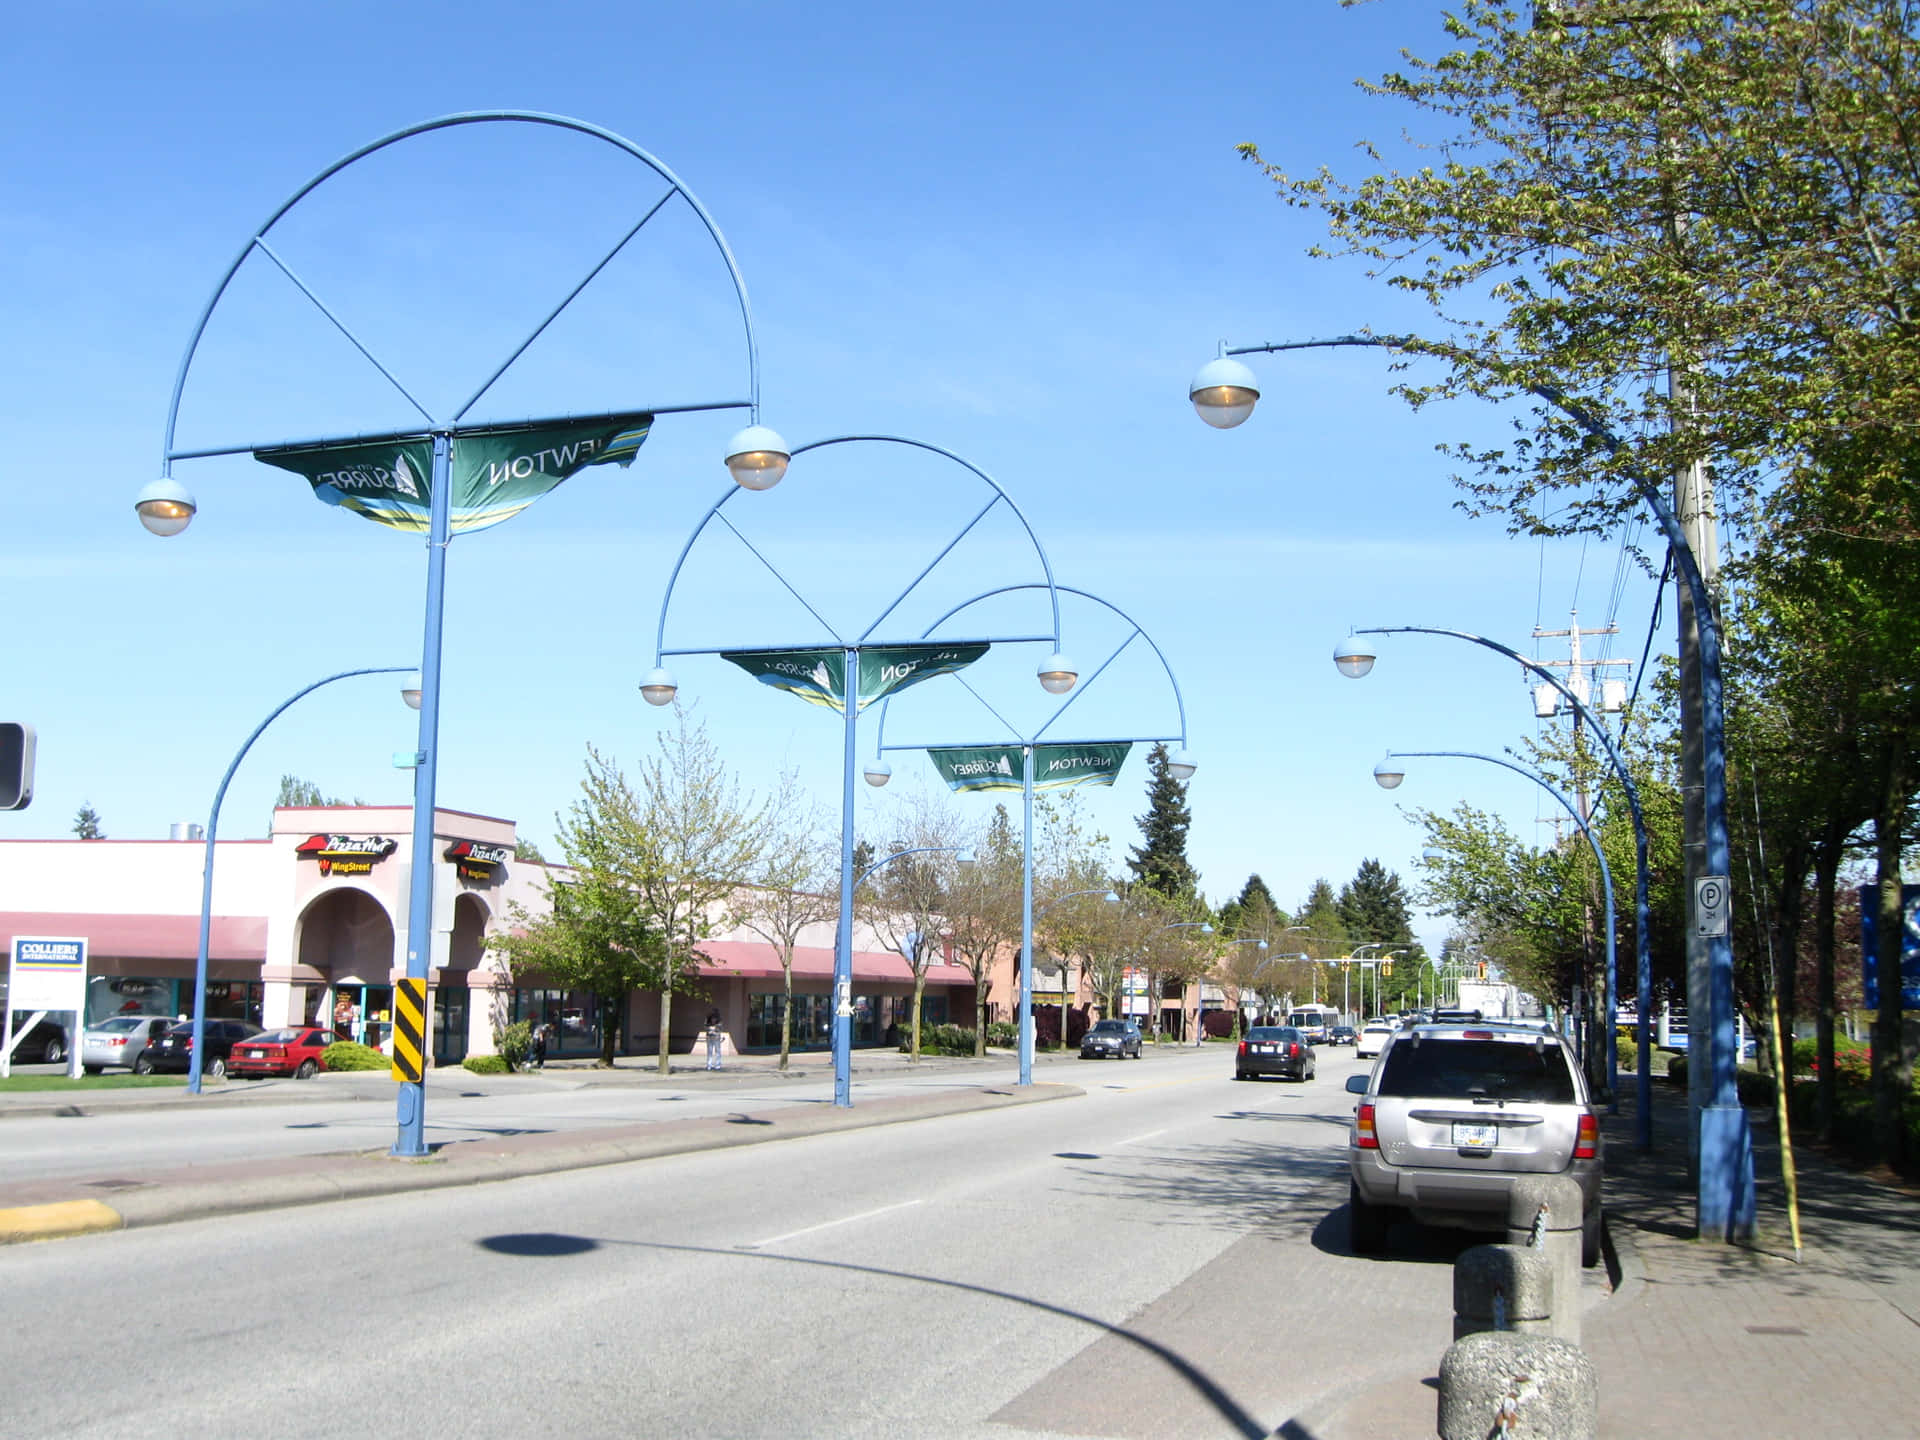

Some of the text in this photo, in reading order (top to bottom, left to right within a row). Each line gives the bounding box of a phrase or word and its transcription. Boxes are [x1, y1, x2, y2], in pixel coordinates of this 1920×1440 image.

[326, 836, 392, 854] Pizza Hut
[331, 862, 371, 873] WingStreet
[1706, 888, 1716, 905] P
[21, 943, 79, 955] COLLIERS
